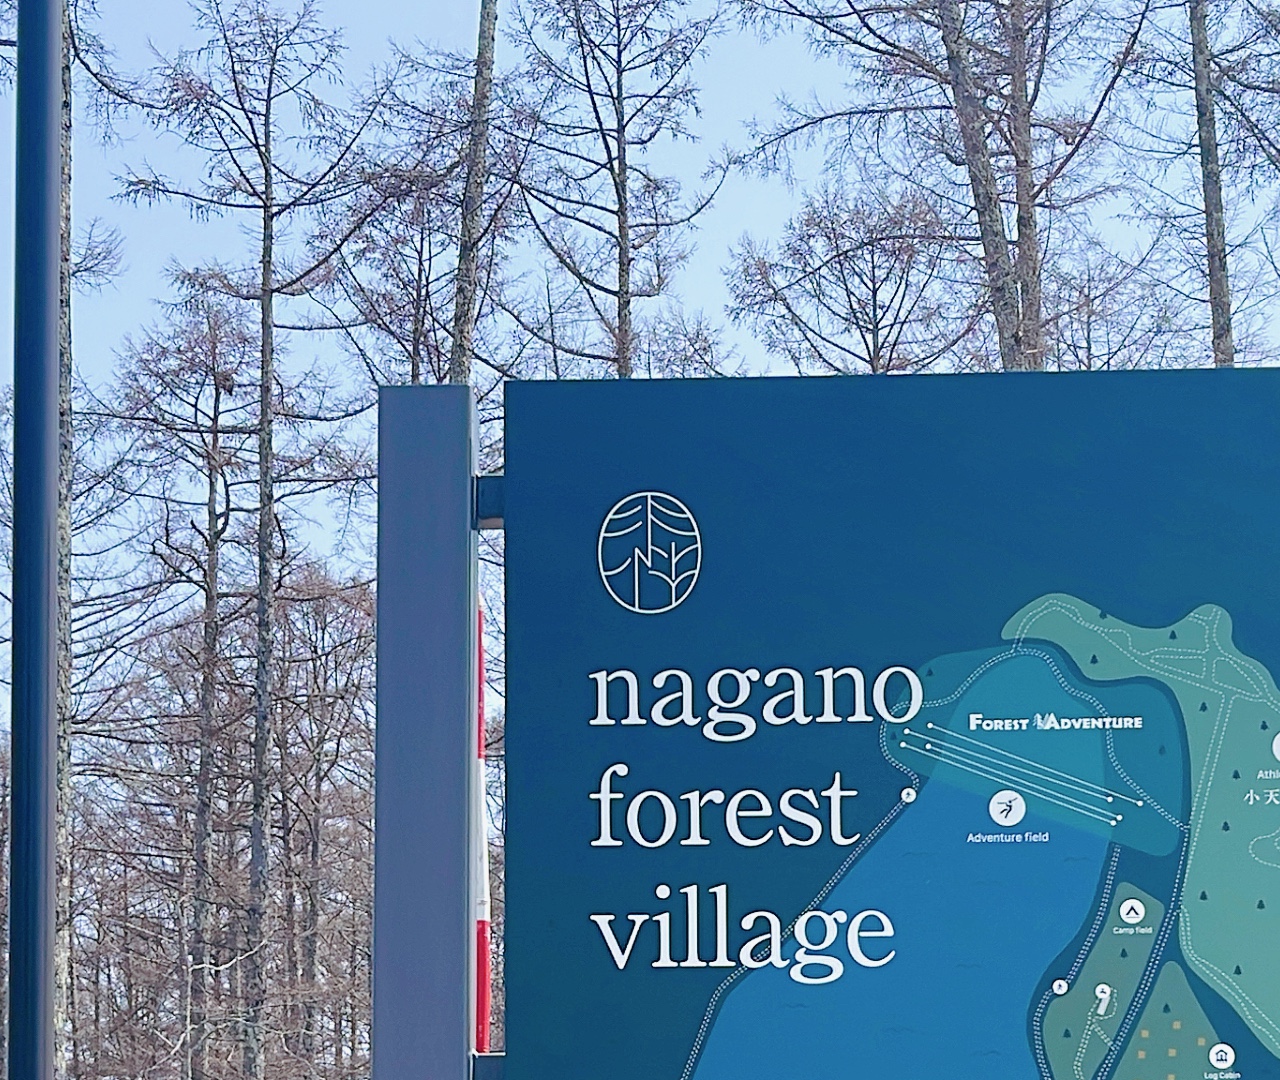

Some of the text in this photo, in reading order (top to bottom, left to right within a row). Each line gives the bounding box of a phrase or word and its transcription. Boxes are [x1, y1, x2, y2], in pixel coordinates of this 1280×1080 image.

[588, 664, 923, 742] nagano
[969, 712, 1143, 731] FOREST ADVENTURE
[590, 764, 862, 849] forest
[967, 832, 1049, 842] Adventure field
[589, 883, 896, 984] village
[1204, 1072, 1220, 1080] Log
